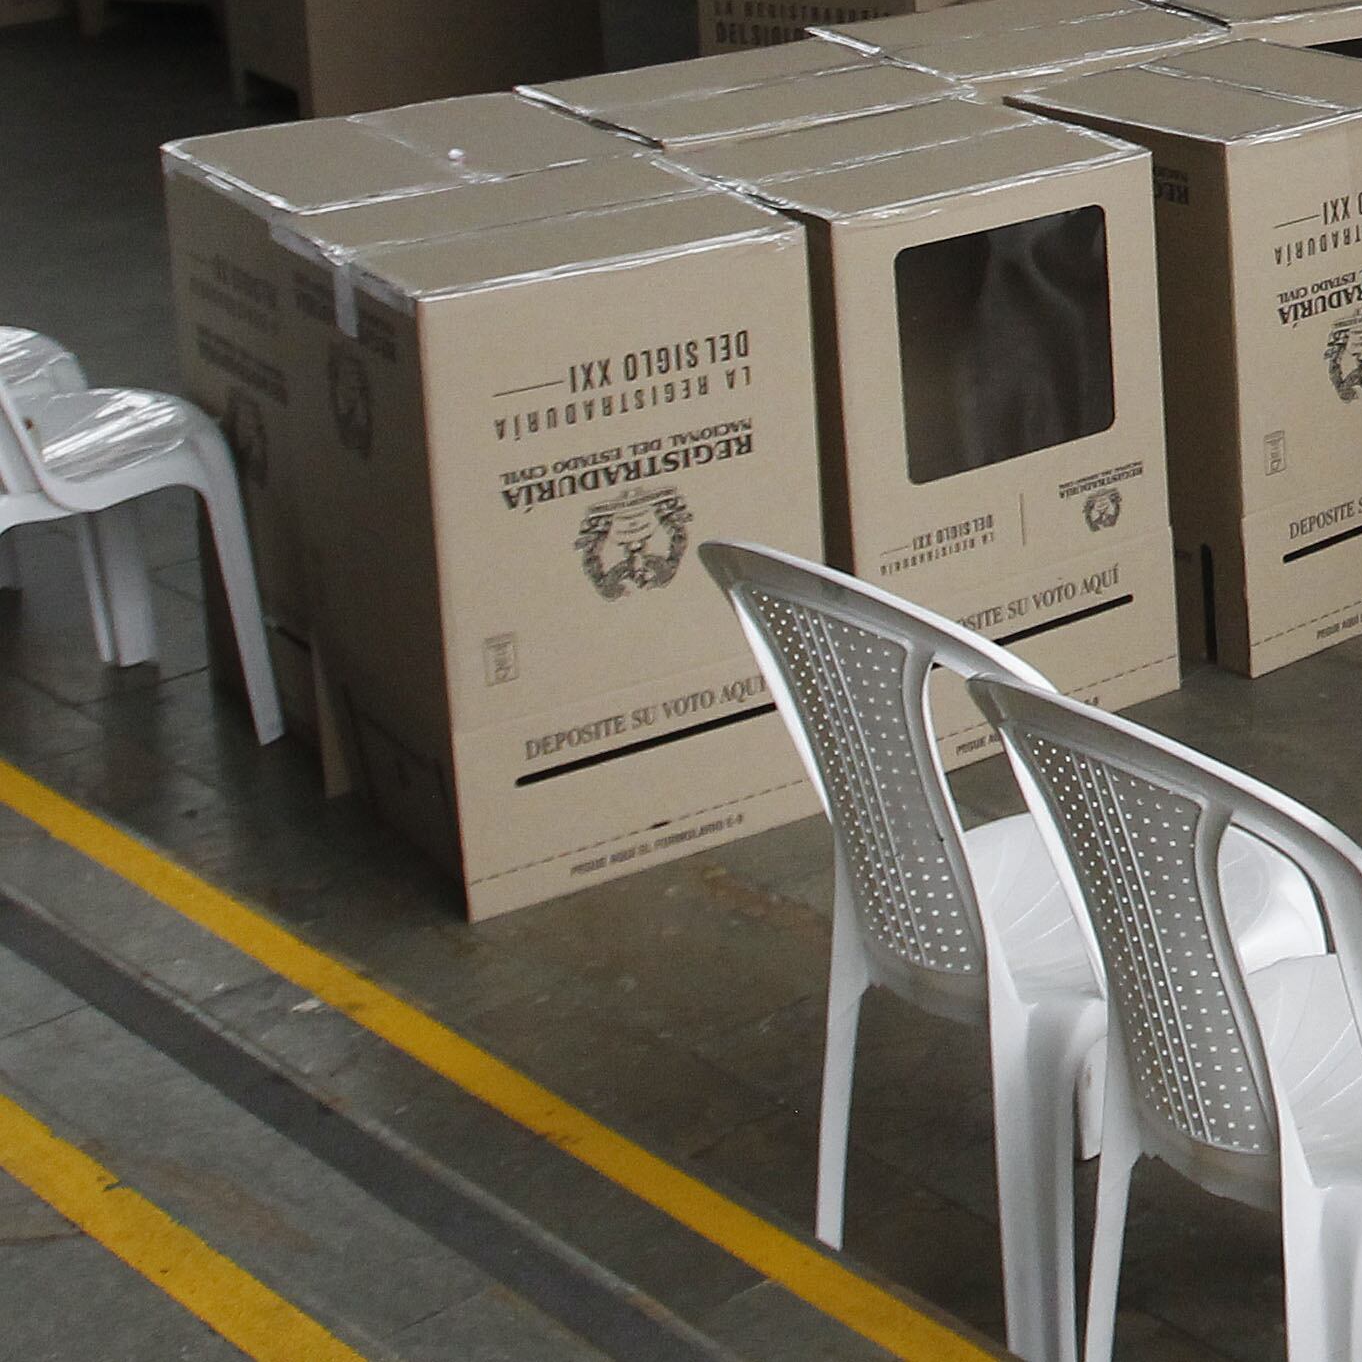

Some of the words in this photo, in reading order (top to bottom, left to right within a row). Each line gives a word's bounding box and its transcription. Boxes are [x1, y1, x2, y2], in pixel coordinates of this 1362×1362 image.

[1323, 194, 1350, 226] XXI
[1311, 269, 1356, 295] ESTADO
[569, 357, 611, 394] XXI
[725, 365, 751, 389] LA
[494, 374, 709, 442] REGISTRADURÍA
[553, 446, 623, 474] ESTADO
[627, 437, 663, 457] DEL
[501, 432, 754, 514] REGISTRADURÍA
[1289, 501, 1355, 540] DEPOSITE
[956, 606, 1002, 631] OSITE
[1007, 598, 1029, 621] SU
[1033, 581, 1077, 610] VOTO
[1079, 563, 1121, 595] AQUÍ
[524, 714, 627, 761] DEPOSITE
[631, 705, 658, 729] SU
[654, 689, 715, 720] VOTO
